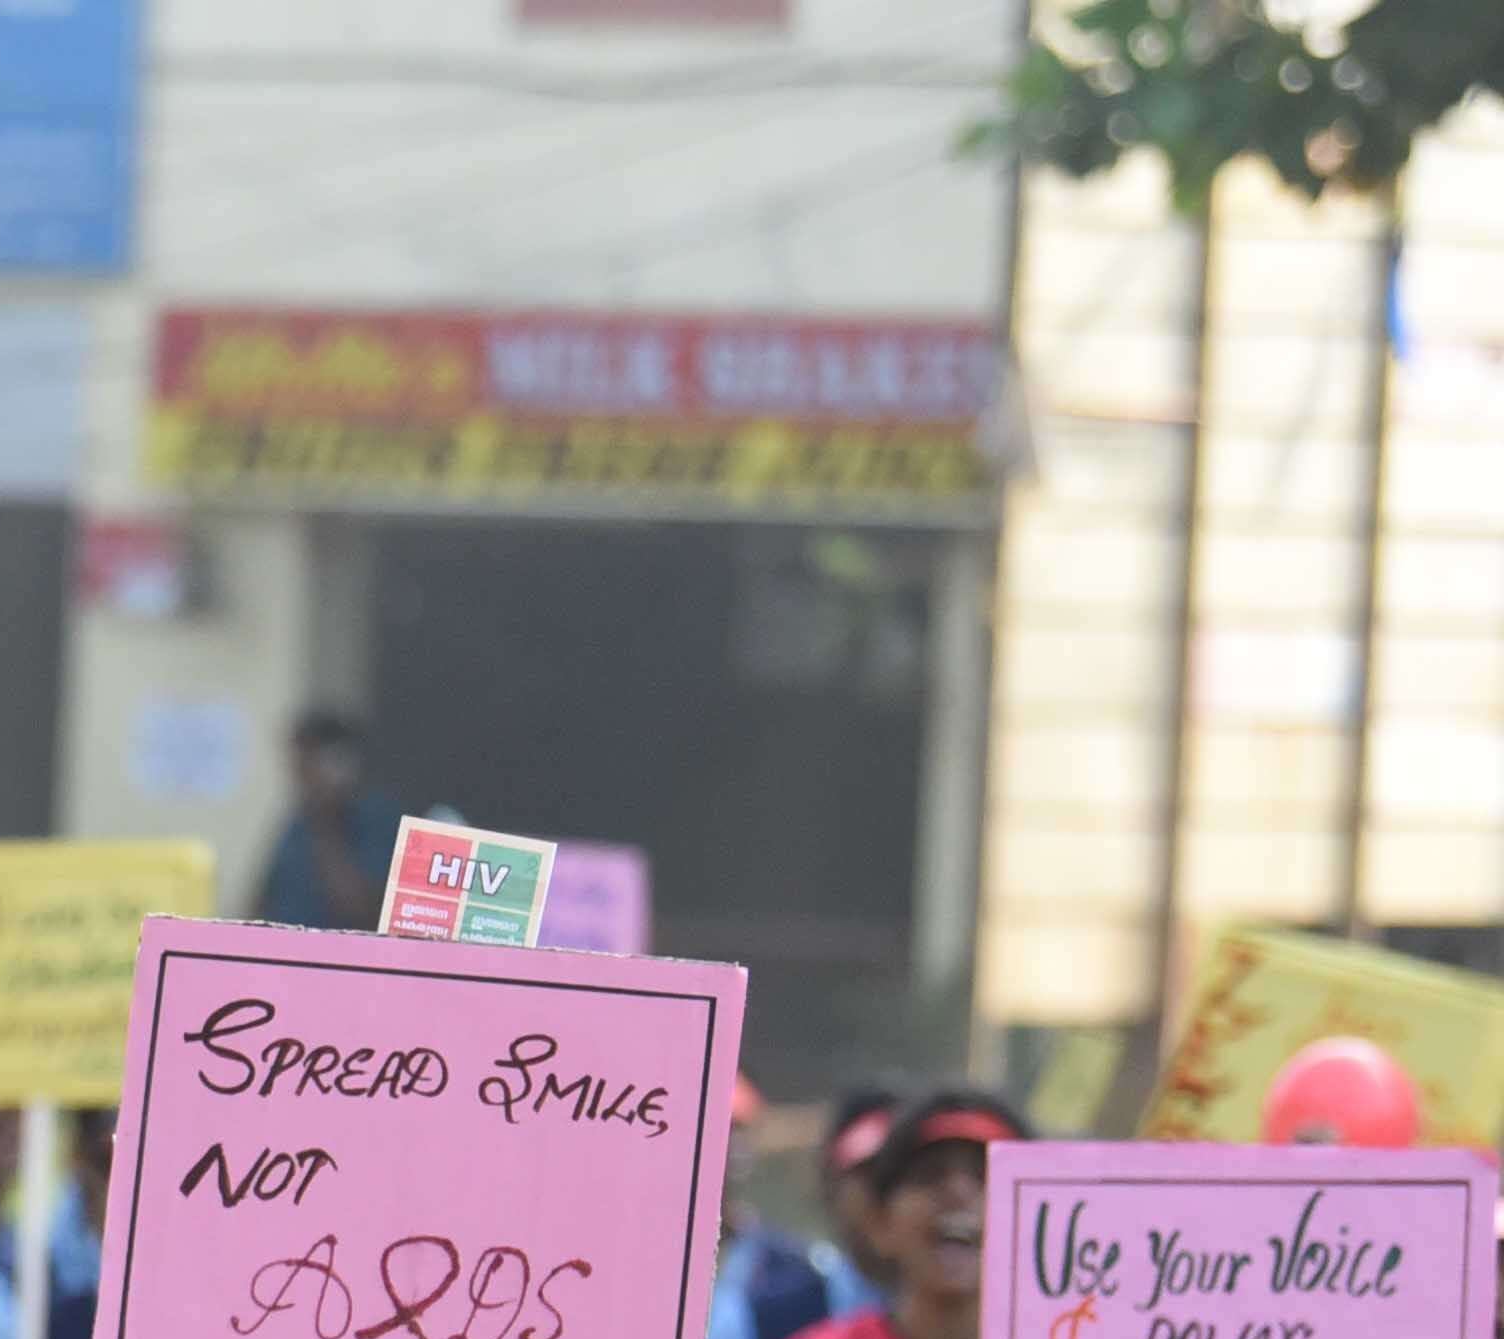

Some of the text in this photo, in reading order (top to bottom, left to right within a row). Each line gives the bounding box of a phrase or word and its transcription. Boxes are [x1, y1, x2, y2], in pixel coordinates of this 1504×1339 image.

[428, 852, 511, 896] HIV
[184, 998, 448, 1097] SPREAD
[179, 1143, 338, 1208] NOT
[1034, 1201, 1121, 1298] Use
